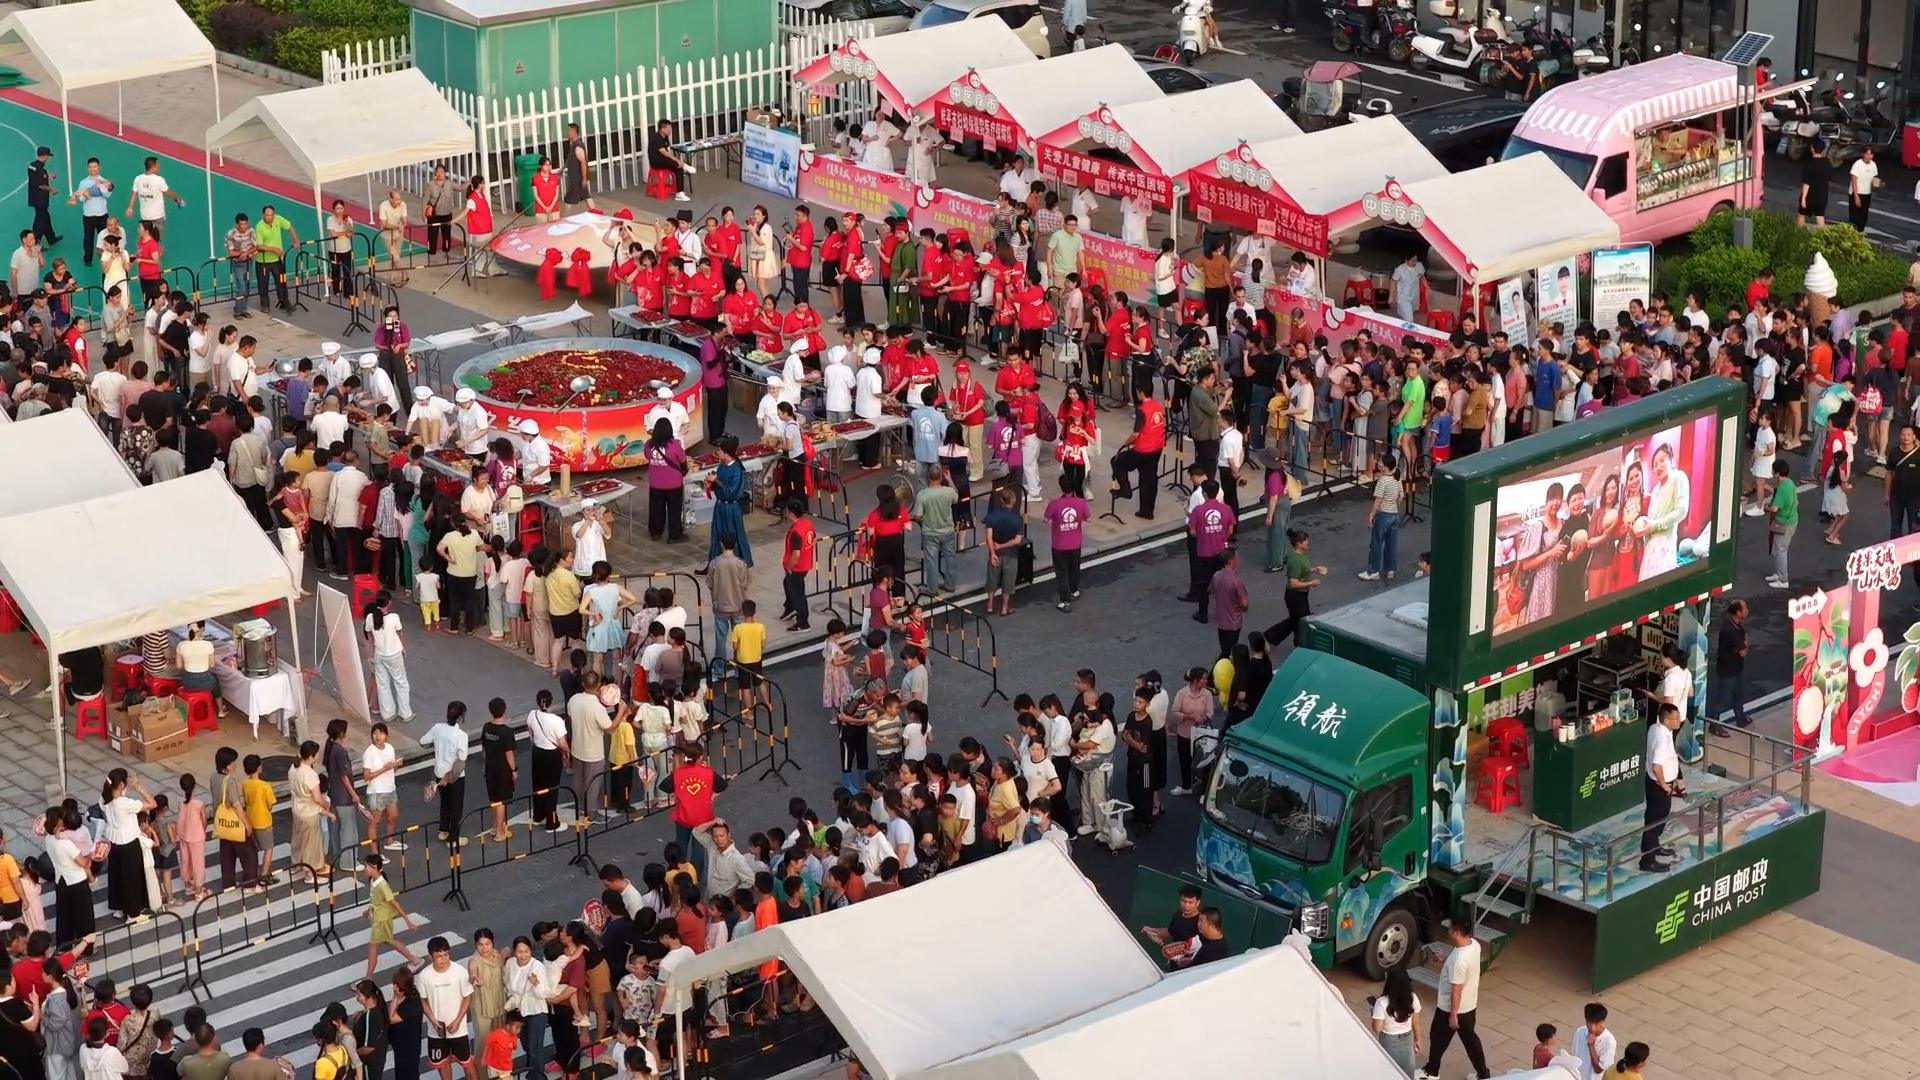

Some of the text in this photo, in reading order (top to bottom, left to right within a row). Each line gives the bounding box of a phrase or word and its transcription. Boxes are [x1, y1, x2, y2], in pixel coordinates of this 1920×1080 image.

[952, 86, 996, 111] 中医夜市
[1081, 120, 1129, 149] 中医夜市
[1044, 147, 1101, 176] 关爱儿童健康
[1108, 165, 1167, 195] 传承中医国粹
[1220, 159, 1270, 187] 中医夜市
[1274, 204, 1324, 239] 大型义诊活动
[1366, 199, 1421, 223] 中医夜市
[1849, 545, 1896, 576] 佳果天成
[1849, 681, 1882, 735] LITCHI
[1600, 754, 1640, 781] 中国邮政
[1600, 768, 1640, 790] CHINA POST
[218, 818, 240, 829] YELLOW
[1693, 857, 1769, 910] 中国邮政
[1692, 883, 1767, 926] CHINA POST
[431, 1048, 442, 1060] 10
